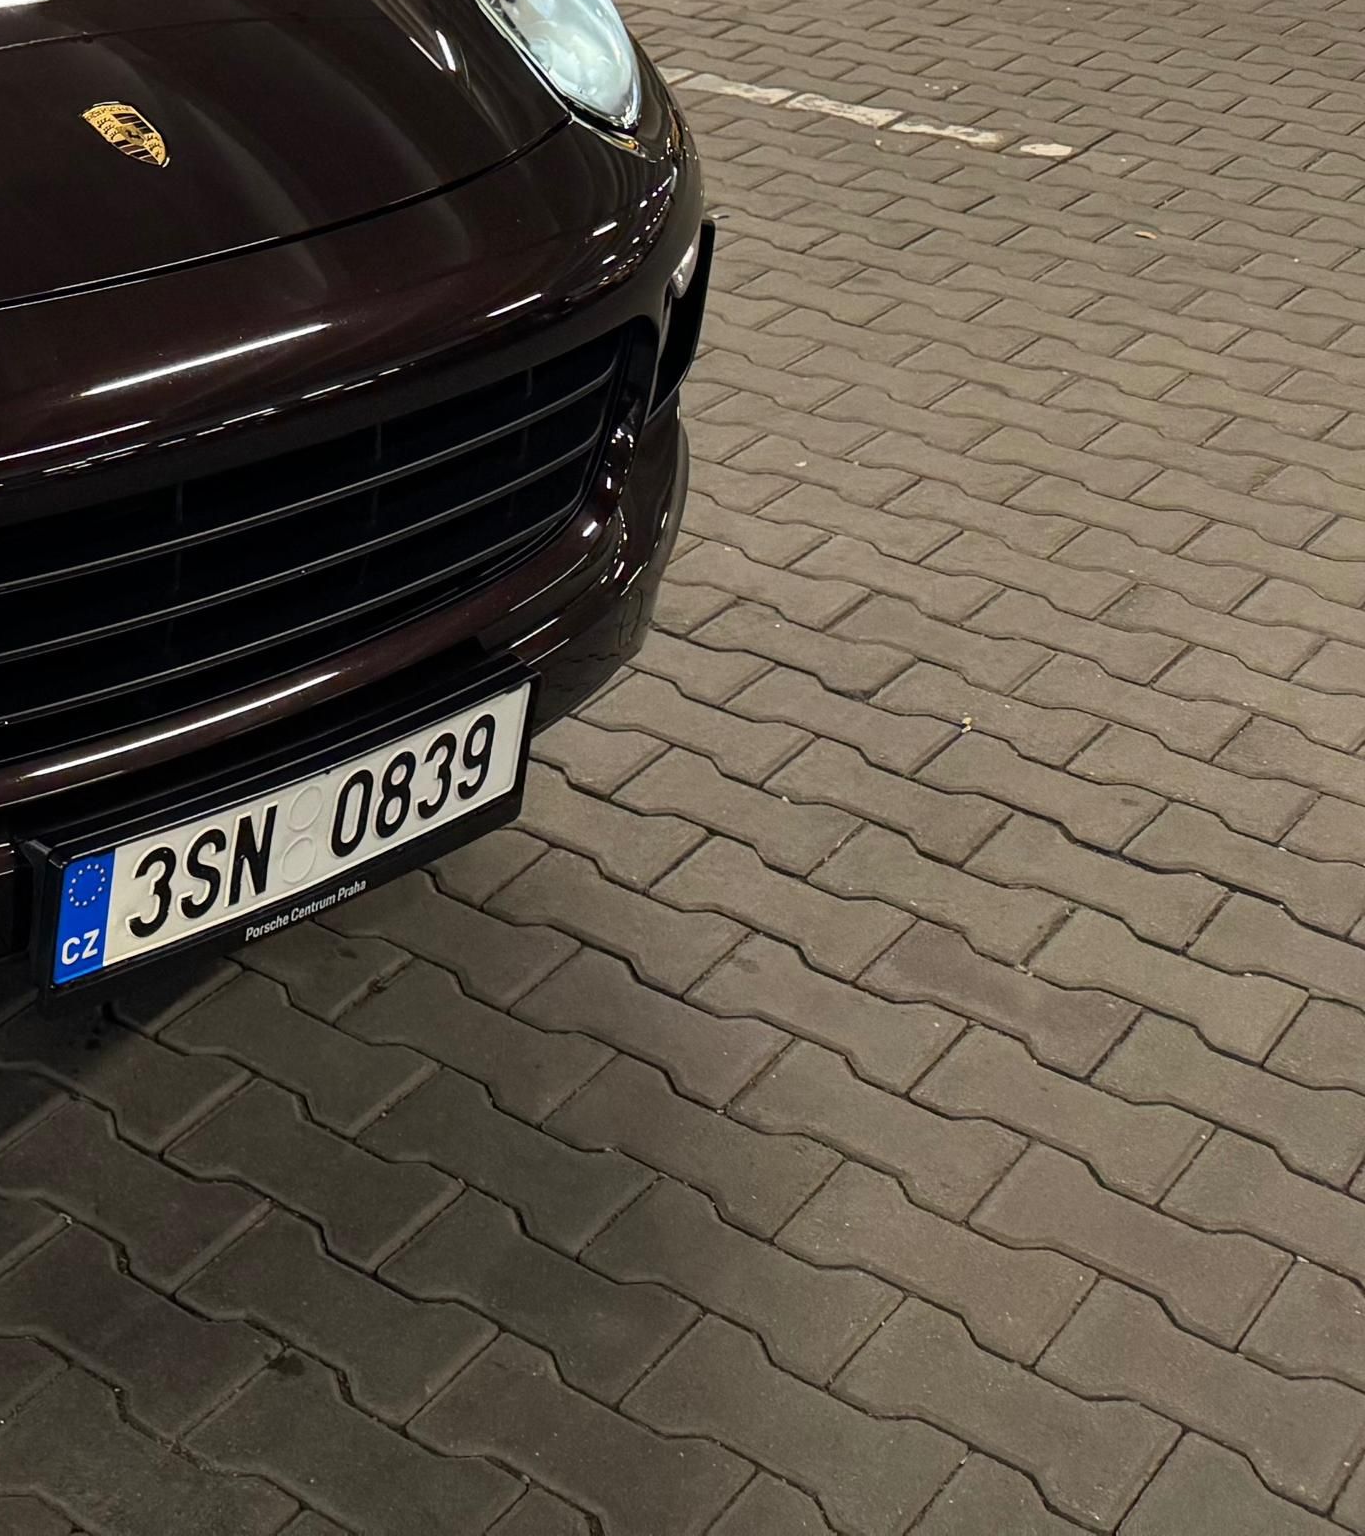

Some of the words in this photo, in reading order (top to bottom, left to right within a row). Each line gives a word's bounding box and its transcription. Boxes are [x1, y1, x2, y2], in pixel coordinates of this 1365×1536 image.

[125, 801, 278, 939] 3SN
[329, 713, 497, 859] 0839
[245, 914, 289, 941] Porsche
[291, 893, 336, 921] Centrum
[337, 880, 367, 902] Praha
[61, 929, 99, 966] CZ
